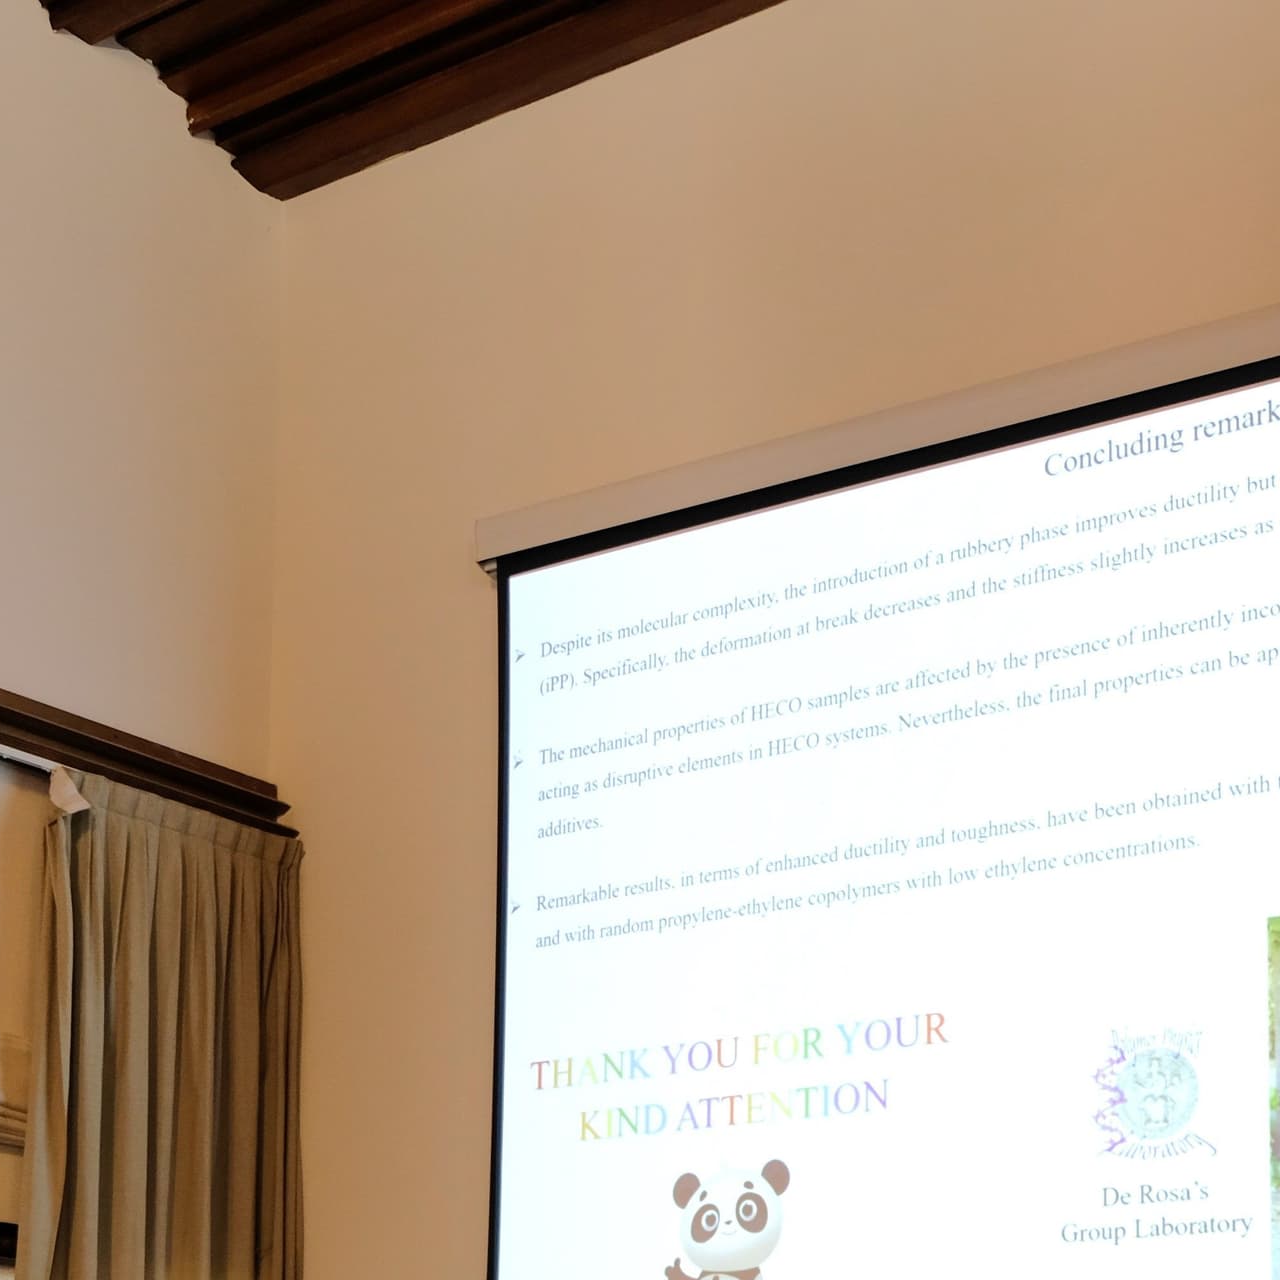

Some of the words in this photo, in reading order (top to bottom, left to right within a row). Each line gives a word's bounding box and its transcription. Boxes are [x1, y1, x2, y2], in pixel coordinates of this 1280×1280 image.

[1044, 428, 1185, 477] Concluding
[539, 633, 593, 659] Despite
[596, 628, 614, 646] its
[616, 610, 689, 641] molecular
[783, 583, 808, 601] the
[812, 560, 909, 595] introduction
[912, 549, 934, 571] of
[949, 535, 1015, 563] rubbery
[1020, 523, 1070, 552] phase
[1075, 503, 1158, 534] improves
[1162, 482, 1241, 513] ductility
[1246, 473, 1277, 495] but
[673, 646, 697, 664] the
[700, 625, 792, 658] deformation
[796, 621, 811, 637] at
[815, 607, 859, 633] break
[863, 593, 942, 622] decreases
[946, 579, 977, 604] and
[981, 576, 1008, 595] the
[1012, 561, 1086, 589] stiffness
[1089, 542, 1157, 572] slightly
[1163, 525, 1248, 556] increases
[1253, 519, 1275, 536] as
[537, 781, 581, 802] acting
[583, 779, 599, 793] as
[602, 764, 674, 790] disruptive
[677, 751, 744, 774] elements
[748, 743, 764, 761] in
[767, 731, 820, 758] HECO
[1016, 689, 1043, 709] the
[1048, 678, 1088, 704] final
[1093, 665, 1184, 700] properties
[1189, 657, 1223, 676] can
[1228, 649, 1251, 668] be
[538, 747, 566, 766] The
[568, 727, 649, 760] mechanical
[652, 716, 727, 747] properties
[729, 705, 749, 727] of
[751, 696, 803, 722] HECO
[807, 684, 871, 711] samples
[875, 680, 900, 697] are
[904, 660, 971, 691] affected
[976, 658, 998, 679] by
[1002, 651, 1029, 671] the
[1034, 637, 1111, 670] presence
[1116, 625, 1138, 648] of
[1141, 608, 1235, 643] inherently
[536, 882, 620, 912] Remarkable
[680, 871, 695, 889] in
[698, 866, 741, 885] terms
[744, 857, 764, 877] of
[764, 845, 839, 873] enhanced
[843, 836, 911, 861] ductility
[915, 827, 945, 849] and
[1047, 808, 1089, 829] have
[1094, 801, 1137, 820] been
[1142, 781, 1222, 813] obtained
[1228, 774, 1271, 797] with
[535, 928, 561, 949] and
[564, 923, 596, 943] with
[599, 917, 655, 939] random
[807, 880, 901, 909] copolymers
[905, 869, 943, 890] with
[948, 866, 979, 886] low
[984, 855, 1057, 881] ethylene
[529, 1047, 653, 1091] THANK
[660, 1036, 739, 1075] YOU
[752, 1026, 825, 1066] FOR
[834, 1012, 949, 1057] YOUR
[579, 1103, 669, 1142] KIND
[675, 1078, 889, 1133] ATTENTION
[1060, 1223, 1127, 1247] Group
[1135, 1215, 1254, 1239] Laboratory
[1101, 1186, 1133, 1208] De
